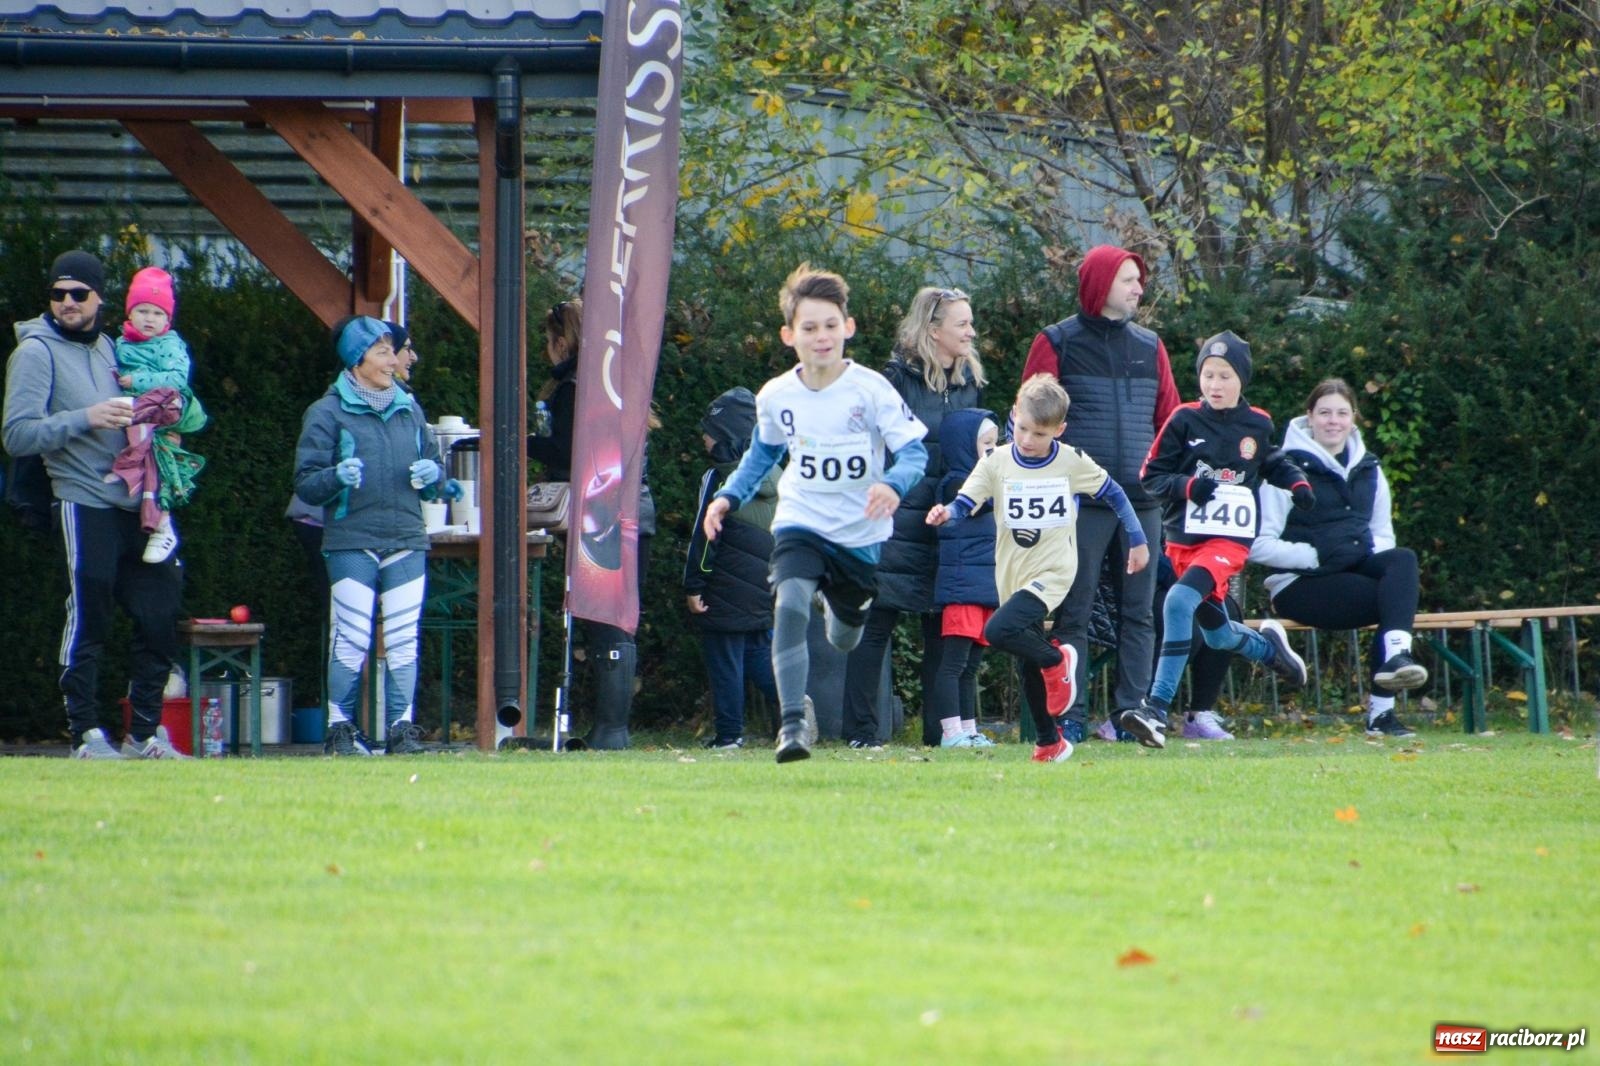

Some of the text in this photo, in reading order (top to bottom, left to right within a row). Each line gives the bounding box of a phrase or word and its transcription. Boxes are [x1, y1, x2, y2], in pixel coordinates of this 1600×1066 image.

[781, 409, 795, 436] 9
[800, 454, 867, 481] 509
[1008, 496, 1067, 519] 554
[1190, 503, 1251, 527] 440
